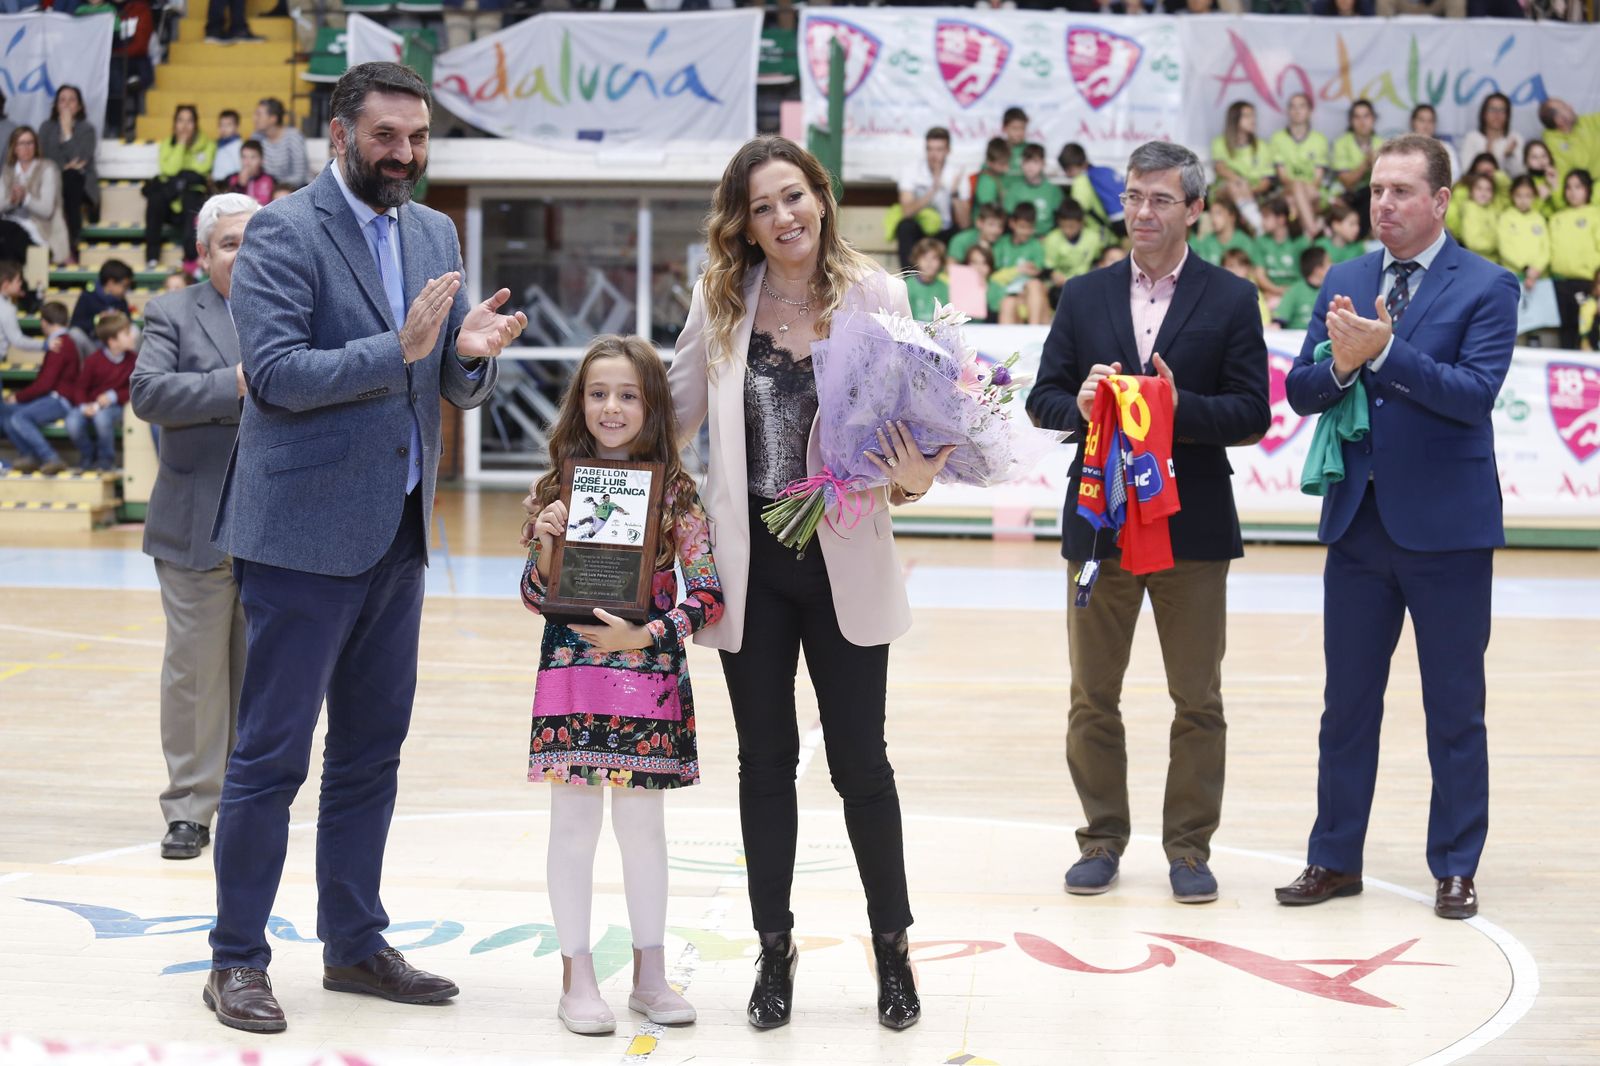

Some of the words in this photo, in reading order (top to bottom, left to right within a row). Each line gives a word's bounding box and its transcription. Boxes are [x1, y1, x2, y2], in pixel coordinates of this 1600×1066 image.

[1213, 28, 1549, 114] Andalucía
[574, 476, 601, 485] JOSÉ
[603, 478, 627, 487] LUIS
[573, 484, 607, 494] PÉREZ
[609, 487, 646, 496] CANCA
